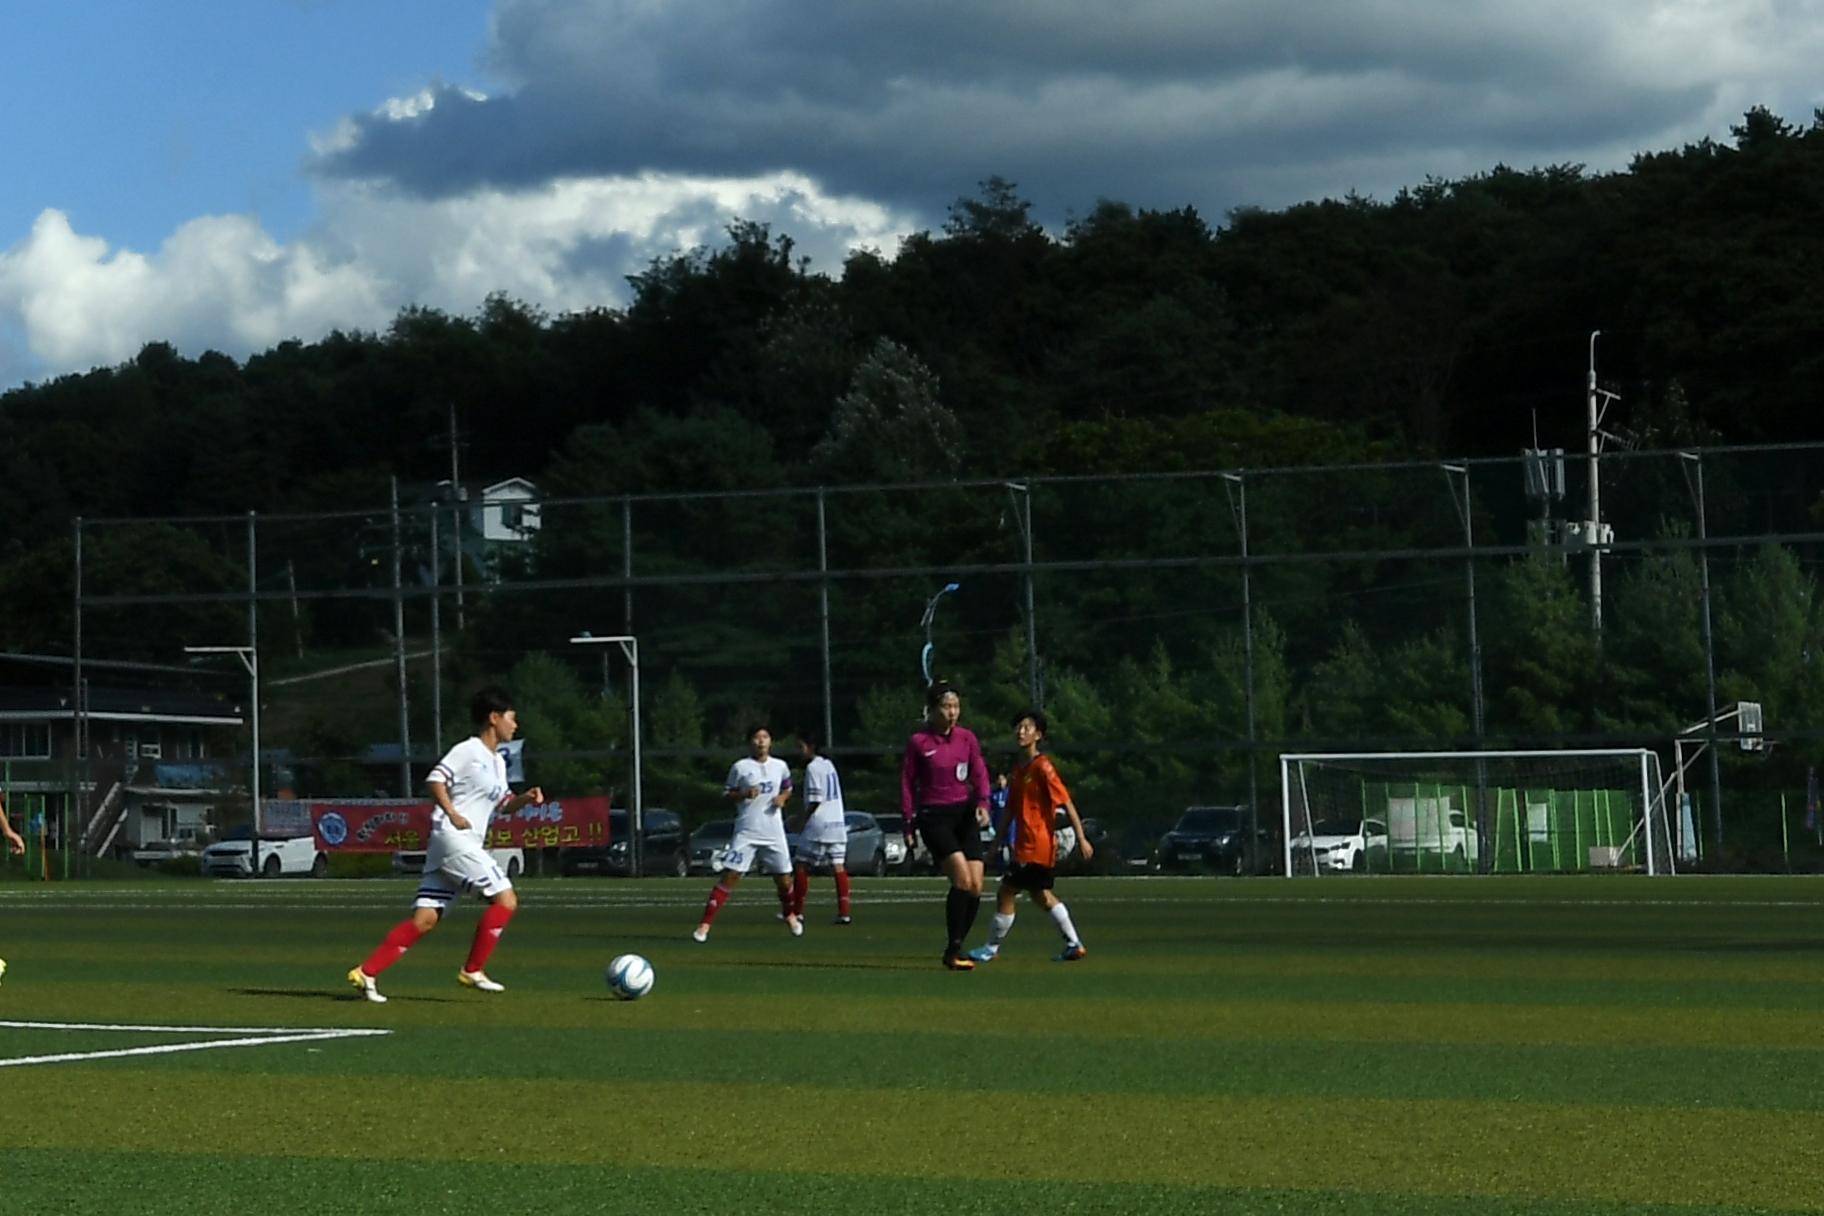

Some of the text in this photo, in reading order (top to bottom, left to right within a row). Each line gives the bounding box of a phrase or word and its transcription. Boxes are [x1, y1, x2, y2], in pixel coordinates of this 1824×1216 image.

[759, 781, 774, 794] 25
[826, 772, 839, 801] 11
[522, 825, 580, 847] 산업고
[729, 850, 744, 865] 25
